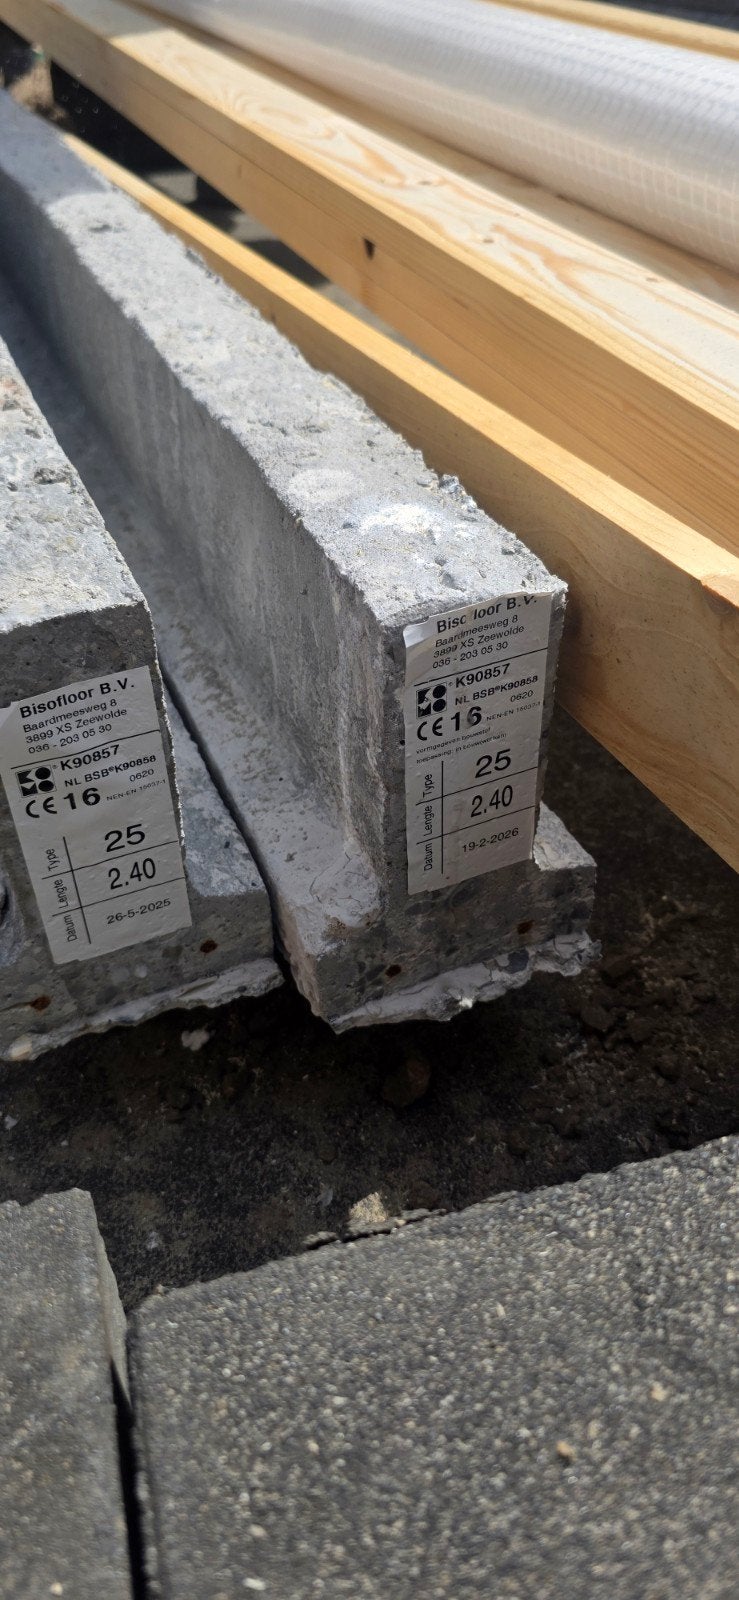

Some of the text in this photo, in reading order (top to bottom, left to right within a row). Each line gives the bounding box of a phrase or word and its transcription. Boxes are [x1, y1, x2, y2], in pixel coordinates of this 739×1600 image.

[506, 595, 537, 611] B.V.
[433, 625, 525, 658] 3899 XS Zeewolde
[435, 615, 518, 648] Baardmeesweg 8
[432, 658, 450, 669] 036
[460, 650, 478, 662] 203
[481, 645, 494, 656] 05
[496, 641, 508, 651] 30
[455, 663, 511, 688] K90857
[20, 678, 134, 718] Bisofloor B.V.
[455, 695, 470, 705] NL
[510, 690, 534, 703] 0620
[23, 699, 117, 733] Baardmeesweg 8
[26, 708, 127, 744] 3899 XS Zeewolde
[450, 706, 482, 731] 16
[28, 743, 50, 754] 036
[60, 733, 80, 747] 203
[82, 730, 96, 740] 05
[98, 723, 112, 734] 30
[60, 744, 120, 771] K90857
[475, 749, 512, 779] 25
[64, 778, 82, 788] NL
[129, 769, 155, 782] 0620
[422, 773, 434, 798] Type
[64, 787, 101, 810] 16
[106, 788, 137, 801] NEN-EN
[470, 785, 513, 818] 2.40
[423, 805, 435, 837] Lengte
[104, 823, 145, 852] 25
[462, 828, 519, 853] 19-2-2026
[46, 848, 61, 871] Type
[423, 842, 433, 872] Datum
[108, 858, 156, 890] 2.40
[54, 879, 69, 909] Lengte
[107, 898, 171, 924] 26-5-2025
[63, 914, 78, 942] Datum
